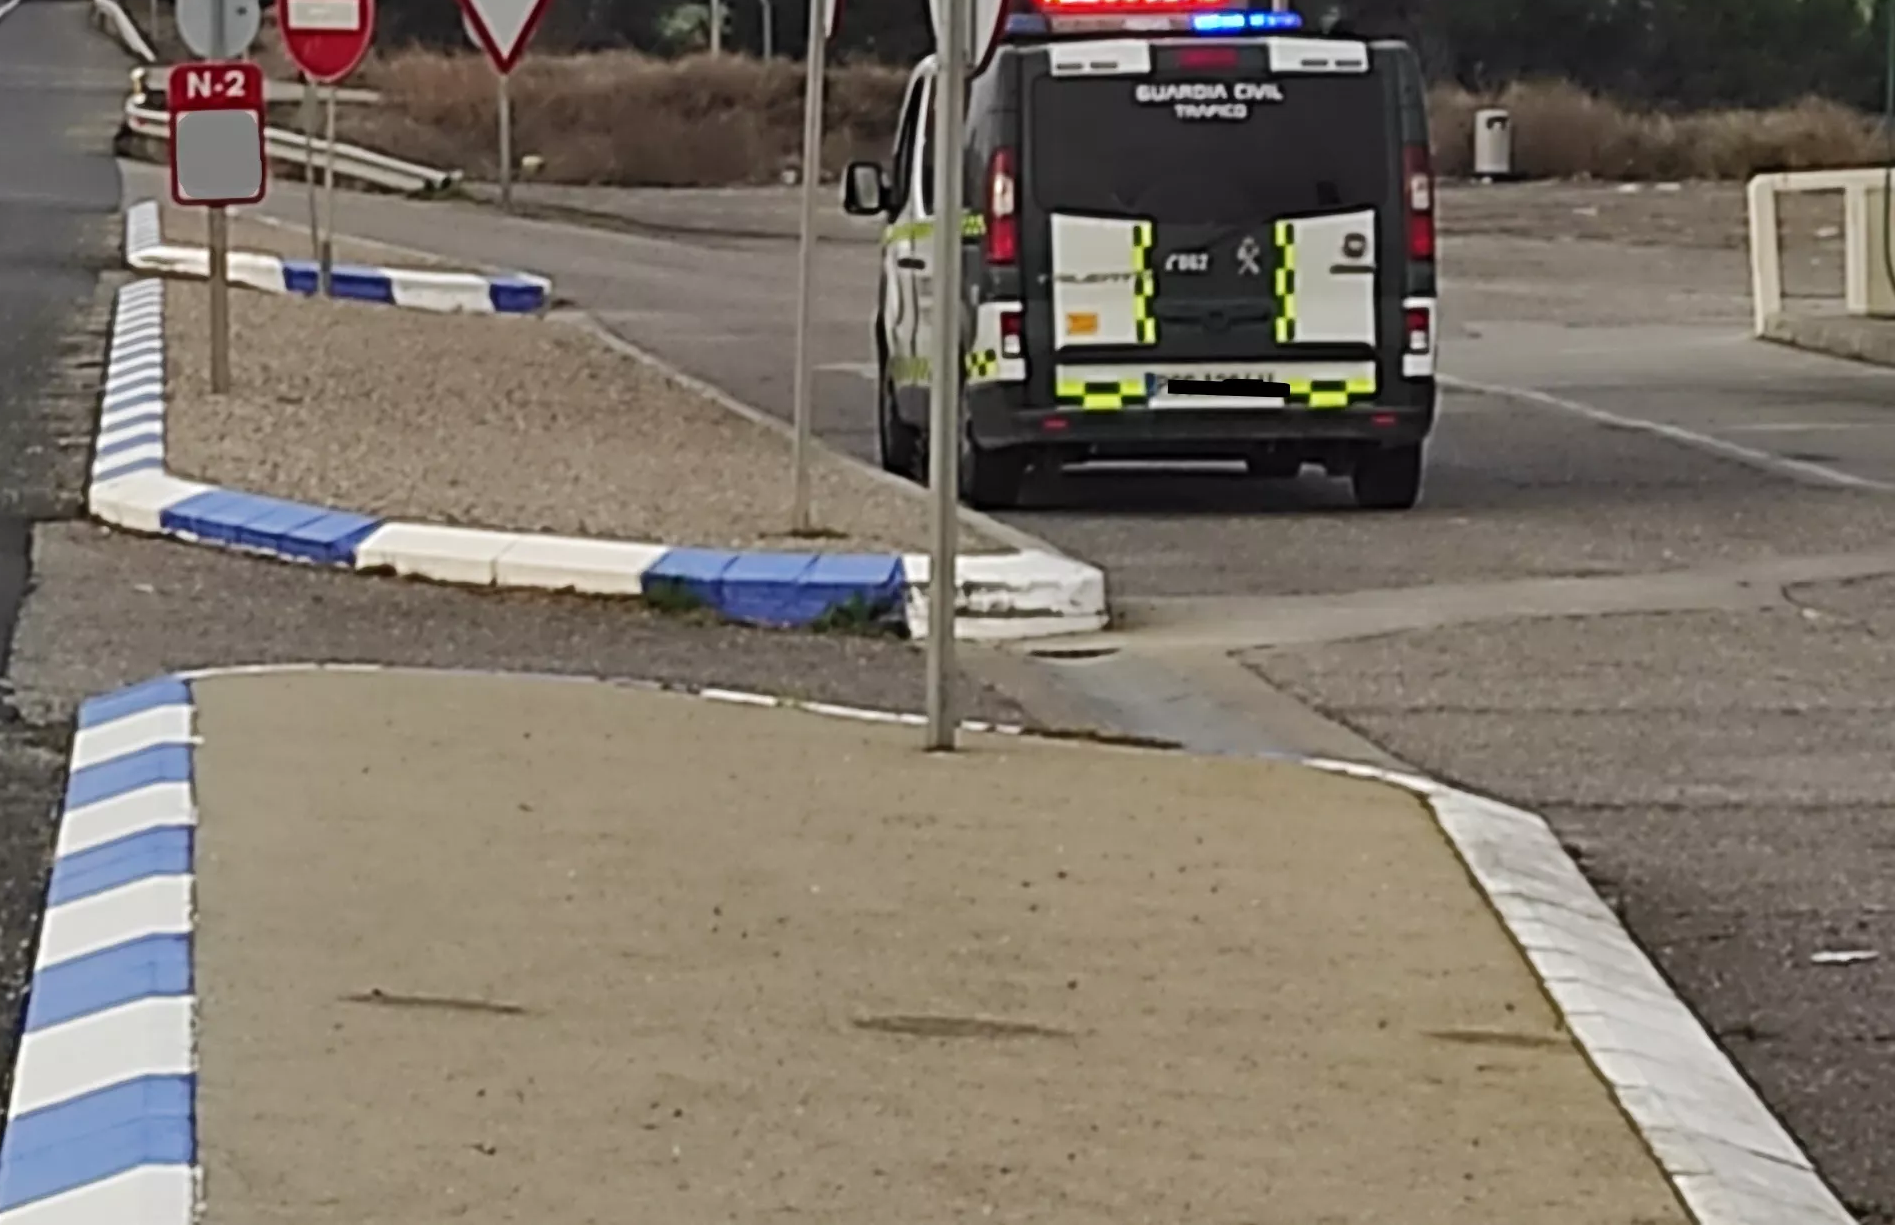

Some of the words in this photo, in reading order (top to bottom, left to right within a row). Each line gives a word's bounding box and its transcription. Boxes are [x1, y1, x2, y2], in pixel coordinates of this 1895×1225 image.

[186, 70, 246, 100] N-2
[1135, 83, 1228, 103] GUARDIA
[1233, 83, 1284, 101] CIVIL
